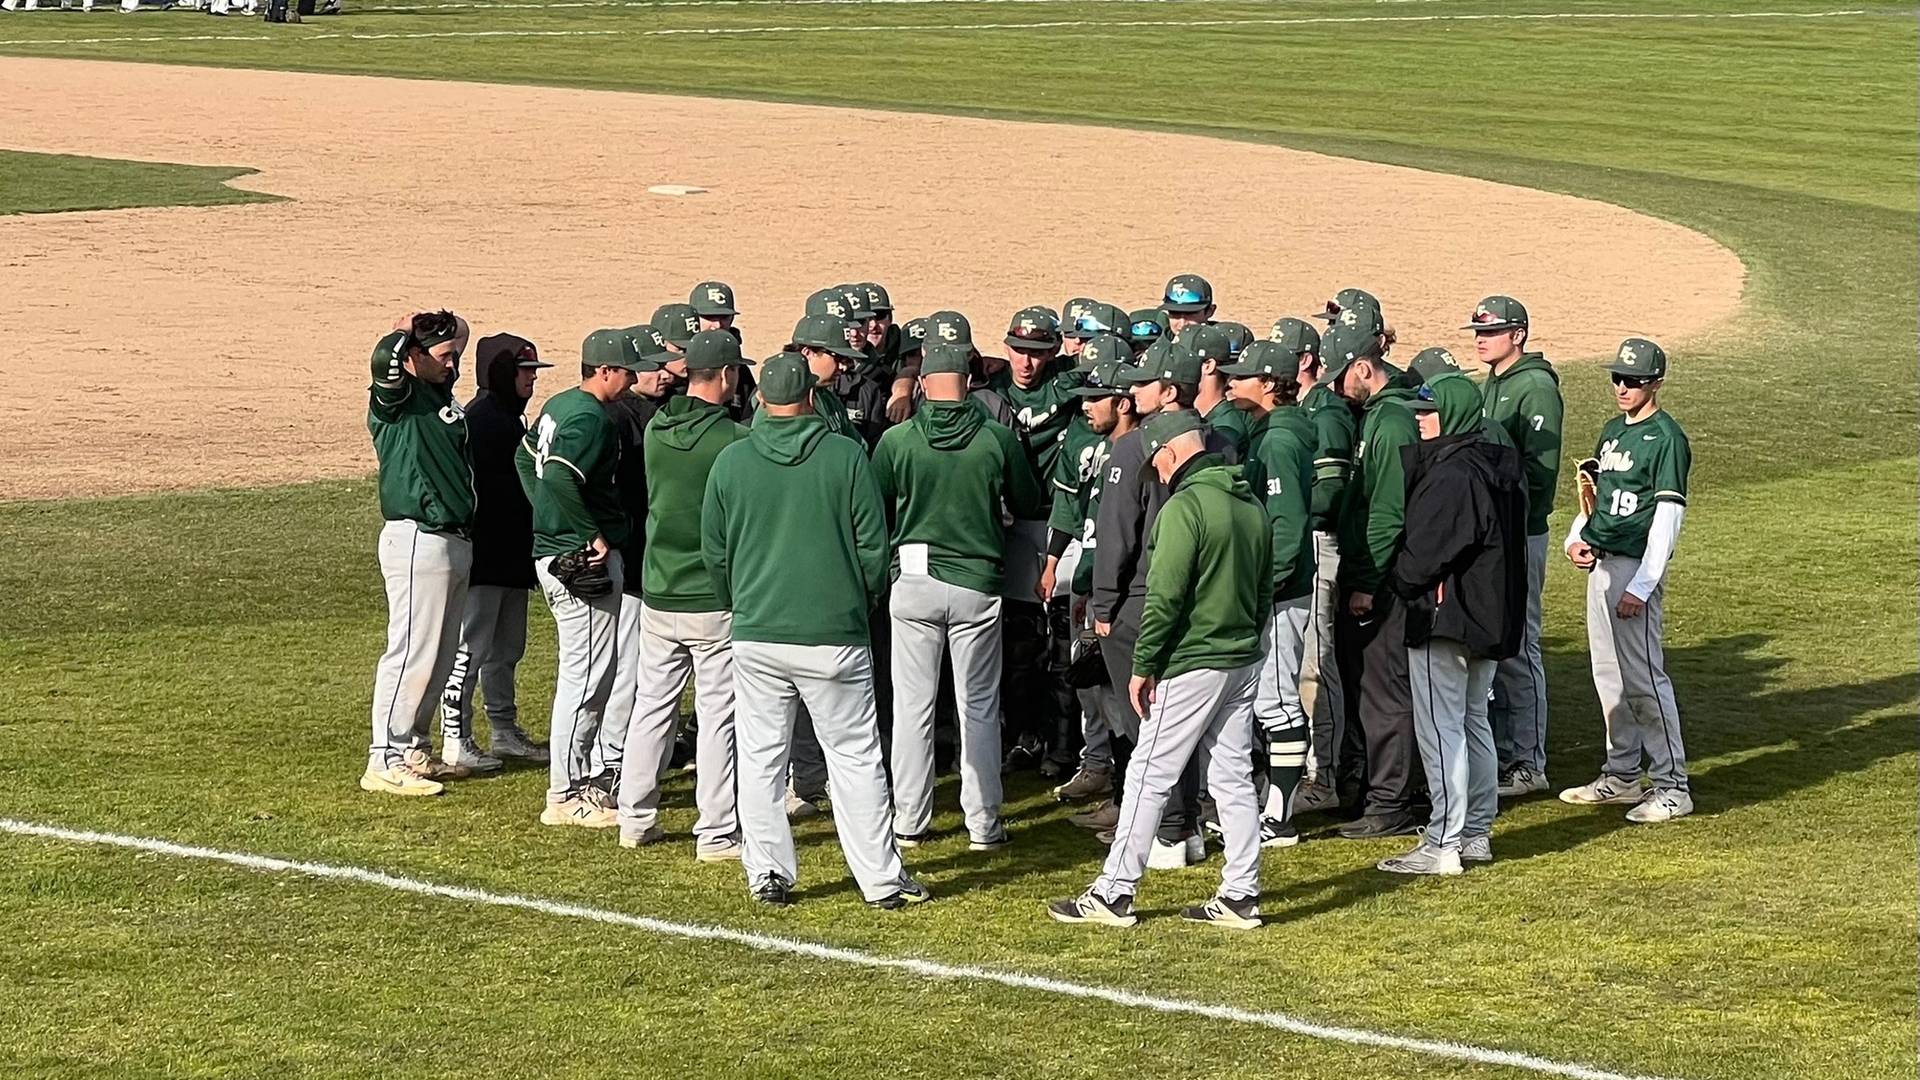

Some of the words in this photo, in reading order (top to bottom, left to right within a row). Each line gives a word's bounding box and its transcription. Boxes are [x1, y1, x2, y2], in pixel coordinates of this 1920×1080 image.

[707, 288, 726, 304] EC
[826, 301, 846, 318] EC
[909, 324, 928, 339] EC
[938, 322, 957, 341] EC
[1619, 346, 1638, 365] EC
[1533, 415, 1544, 431] 7
[1108, 467, 1122, 484] 13
[1267, 477, 1282, 495] 31
[1609, 488, 1639, 517] 19
[445, 652, 470, 702] NIKE
[443, 703, 461, 738] AIR
